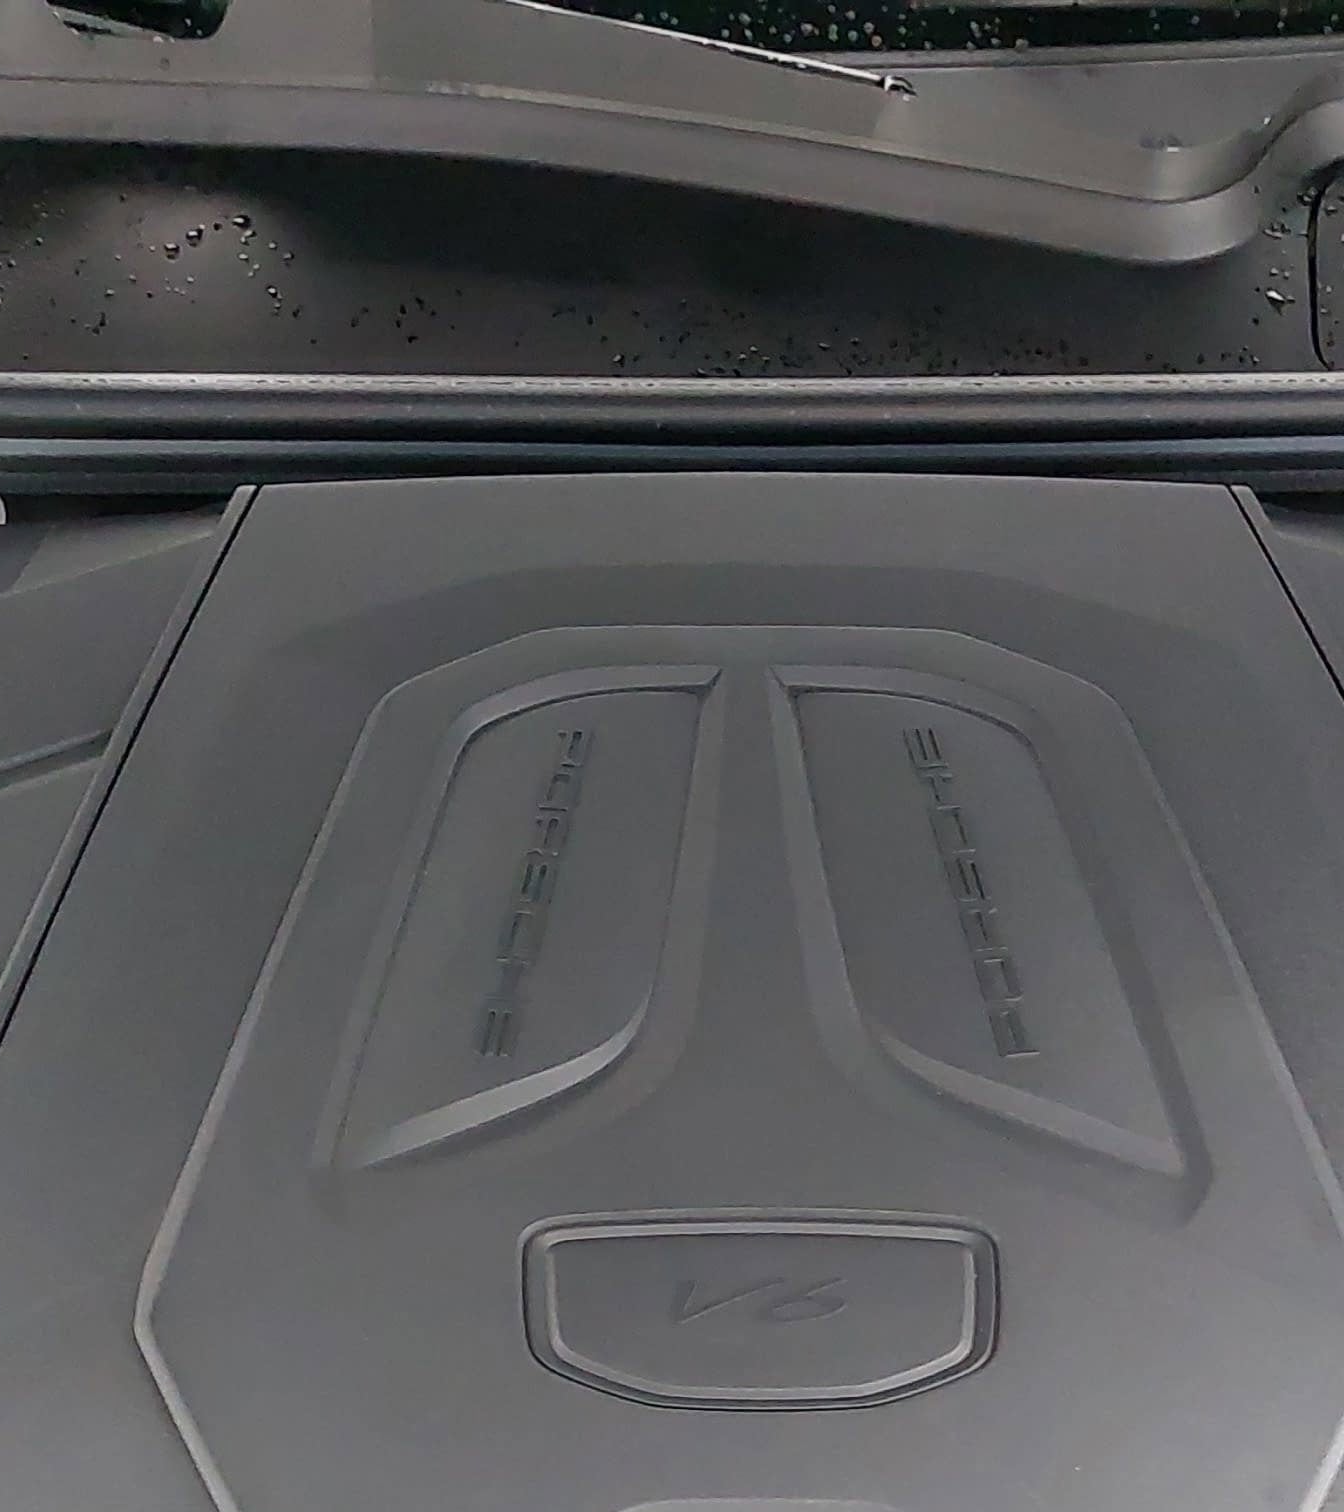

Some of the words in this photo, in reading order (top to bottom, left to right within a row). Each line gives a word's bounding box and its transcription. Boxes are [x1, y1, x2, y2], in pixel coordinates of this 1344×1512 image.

[476, 729, 594, 1057] PORSCHE
[902, 727, 1041, 1057] PORSCHE
[672, 1277, 849, 1326] V6
